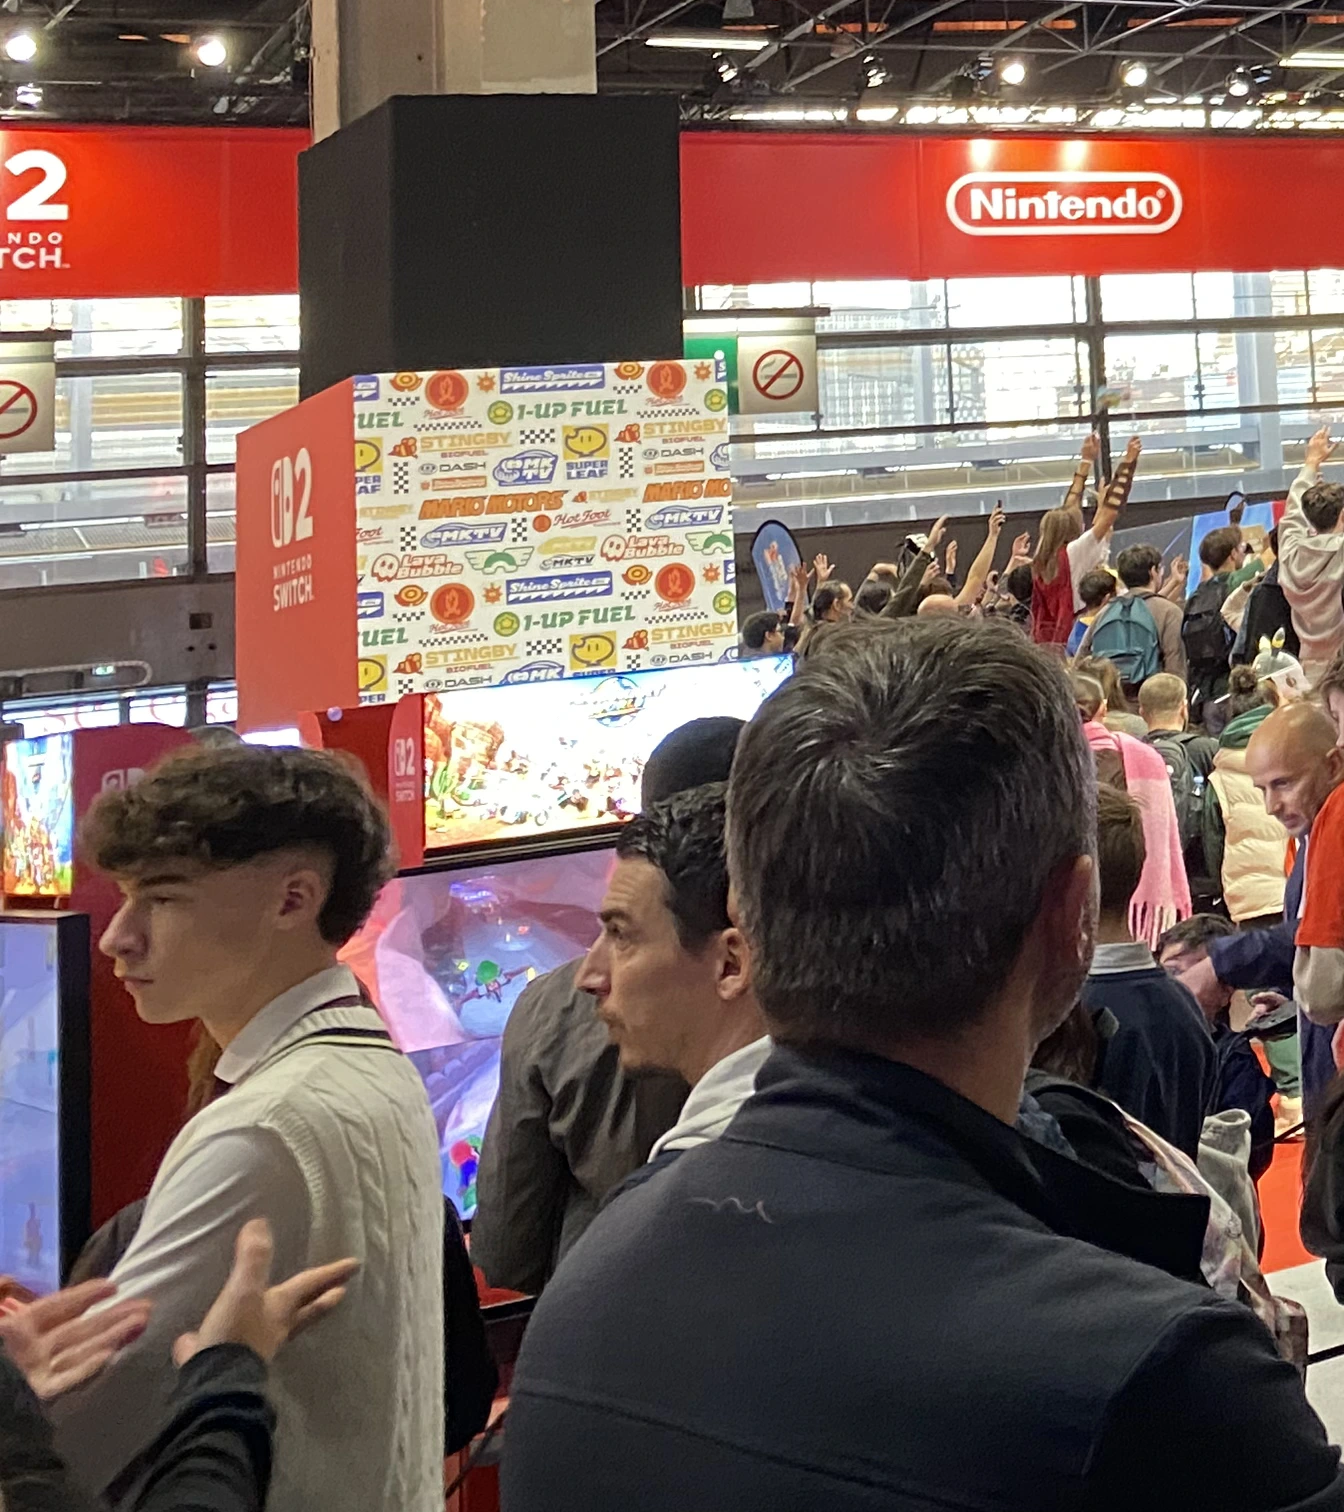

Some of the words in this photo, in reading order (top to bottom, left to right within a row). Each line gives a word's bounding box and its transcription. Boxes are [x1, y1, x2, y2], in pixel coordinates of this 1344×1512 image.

[970, 187, 1163, 221] Nintendo
[516, 402, 568, 421] 1-UP
[570, 398, 628, 418] FUEL
[643, 418, 728, 436] STINGBY
[420, 431, 513, 450] STINGBY
[660, 447, 705, 458] DASH
[438, 461, 487, 474] DASH
[565, 459, 609, 471] SUPER
[418, 495, 488, 521] MARIO
[485, 489, 569, 516] MOTORS
[396, 561, 464, 580] Bubble
[400, 554, 447, 568] Lava
[273, 575, 314, 613] SWITCH
[508, 579, 548, 594] Shine
[550, 577, 592, 592] Sprite
[523, 610, 575, 632] 1-UP
[577, 604, 636, 627] FUEL
[651, 620, 736, 642] STINGBY
[425, 643, 518, 665] STINGBY
[668, 651, 713, 664] DASH
[444, 675, 493, 688] DASH
